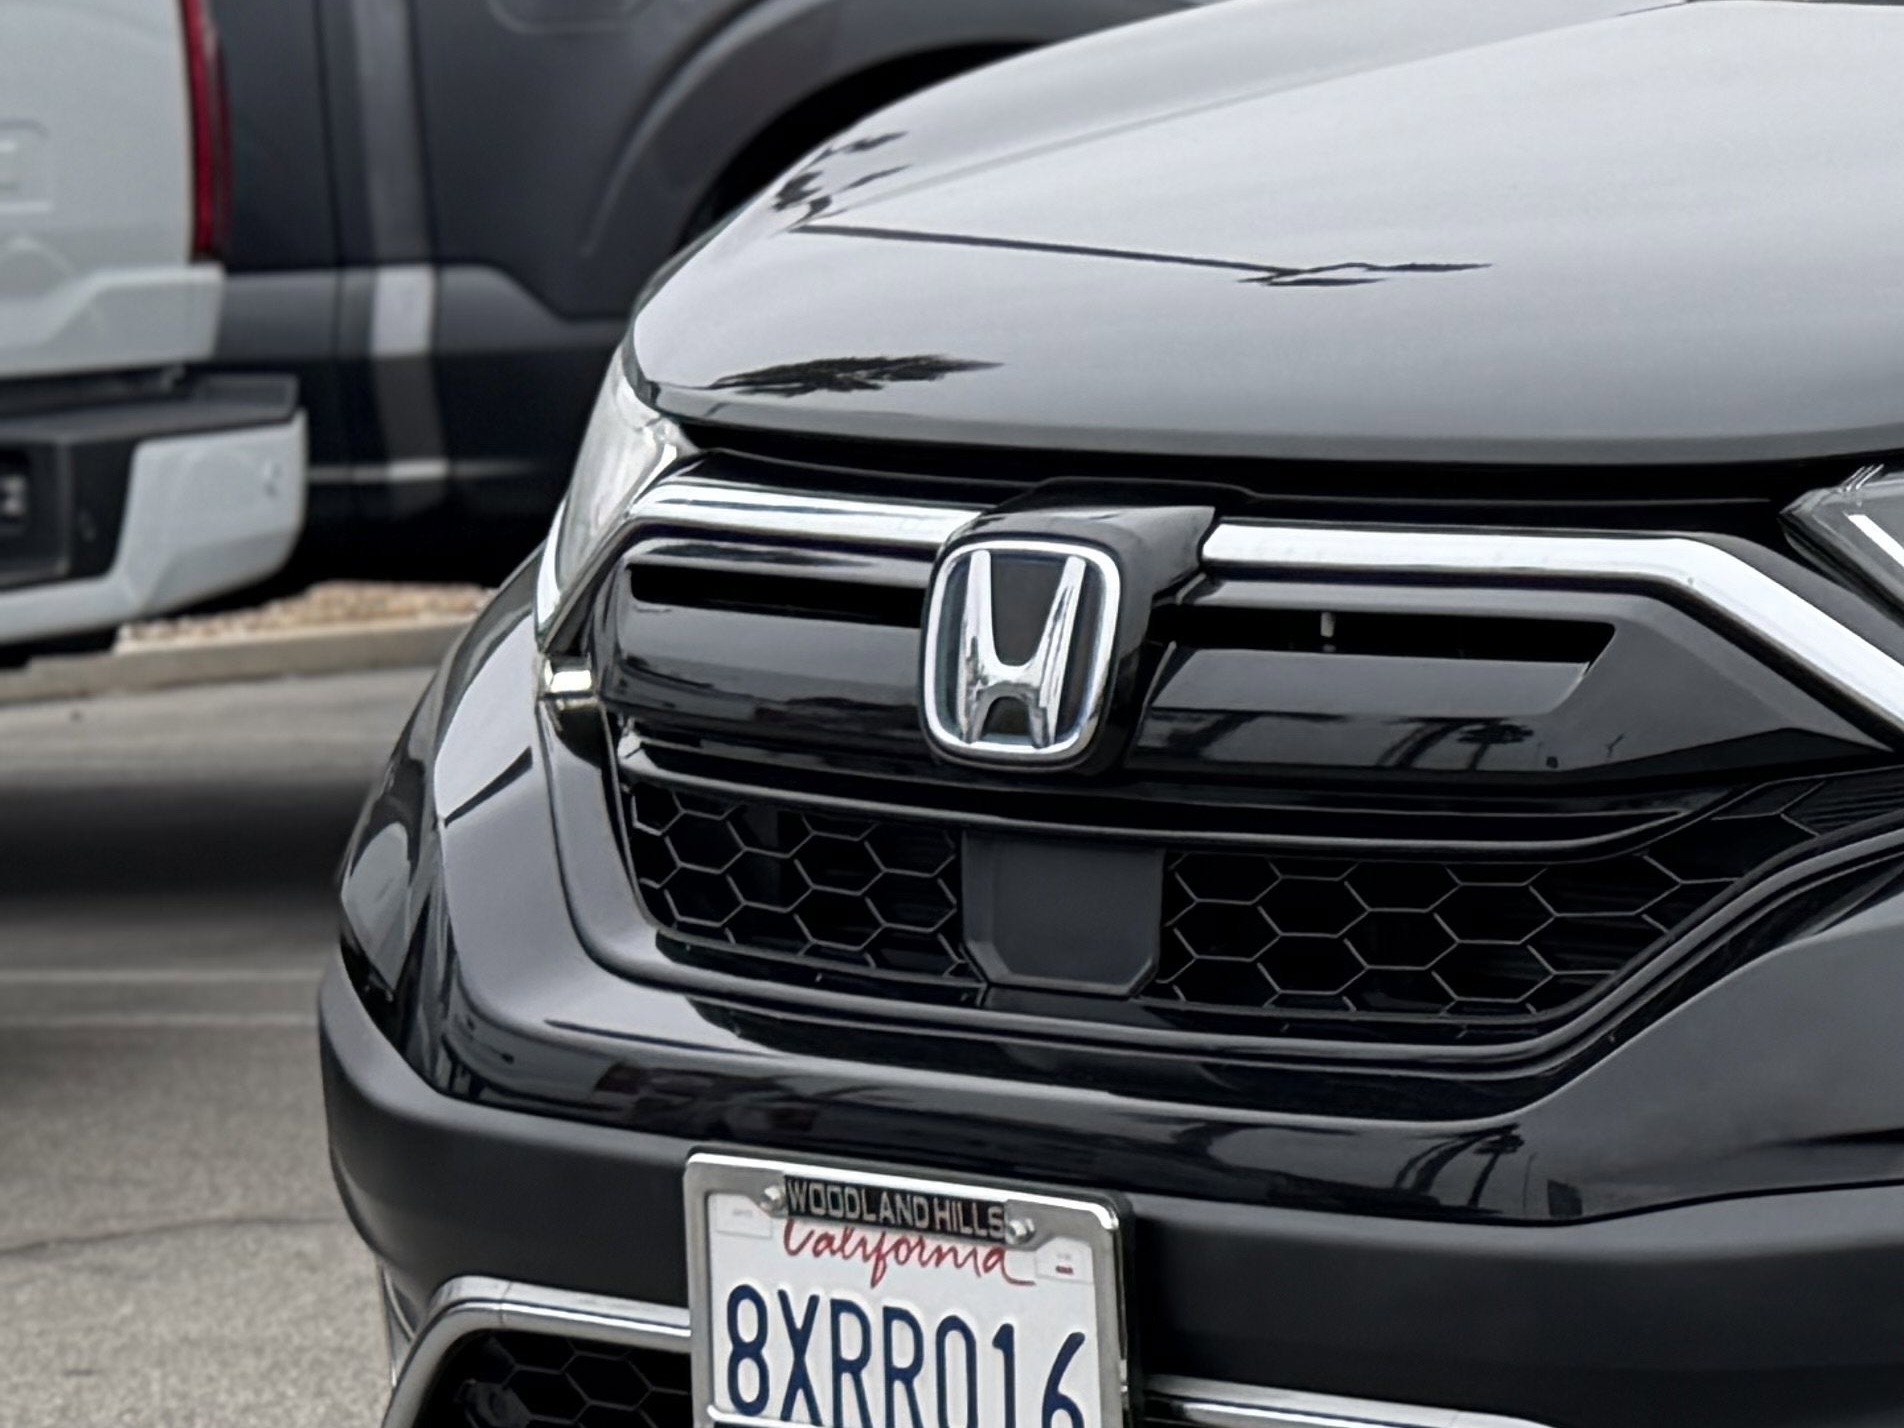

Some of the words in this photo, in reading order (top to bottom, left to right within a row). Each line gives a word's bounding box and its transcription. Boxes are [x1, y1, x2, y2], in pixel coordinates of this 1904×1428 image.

[788, 1180, 929, 1229] WOODLAND
[933, 1199, 1004, 1239] HILLS
[783, 1219, 1036, 1289] California
